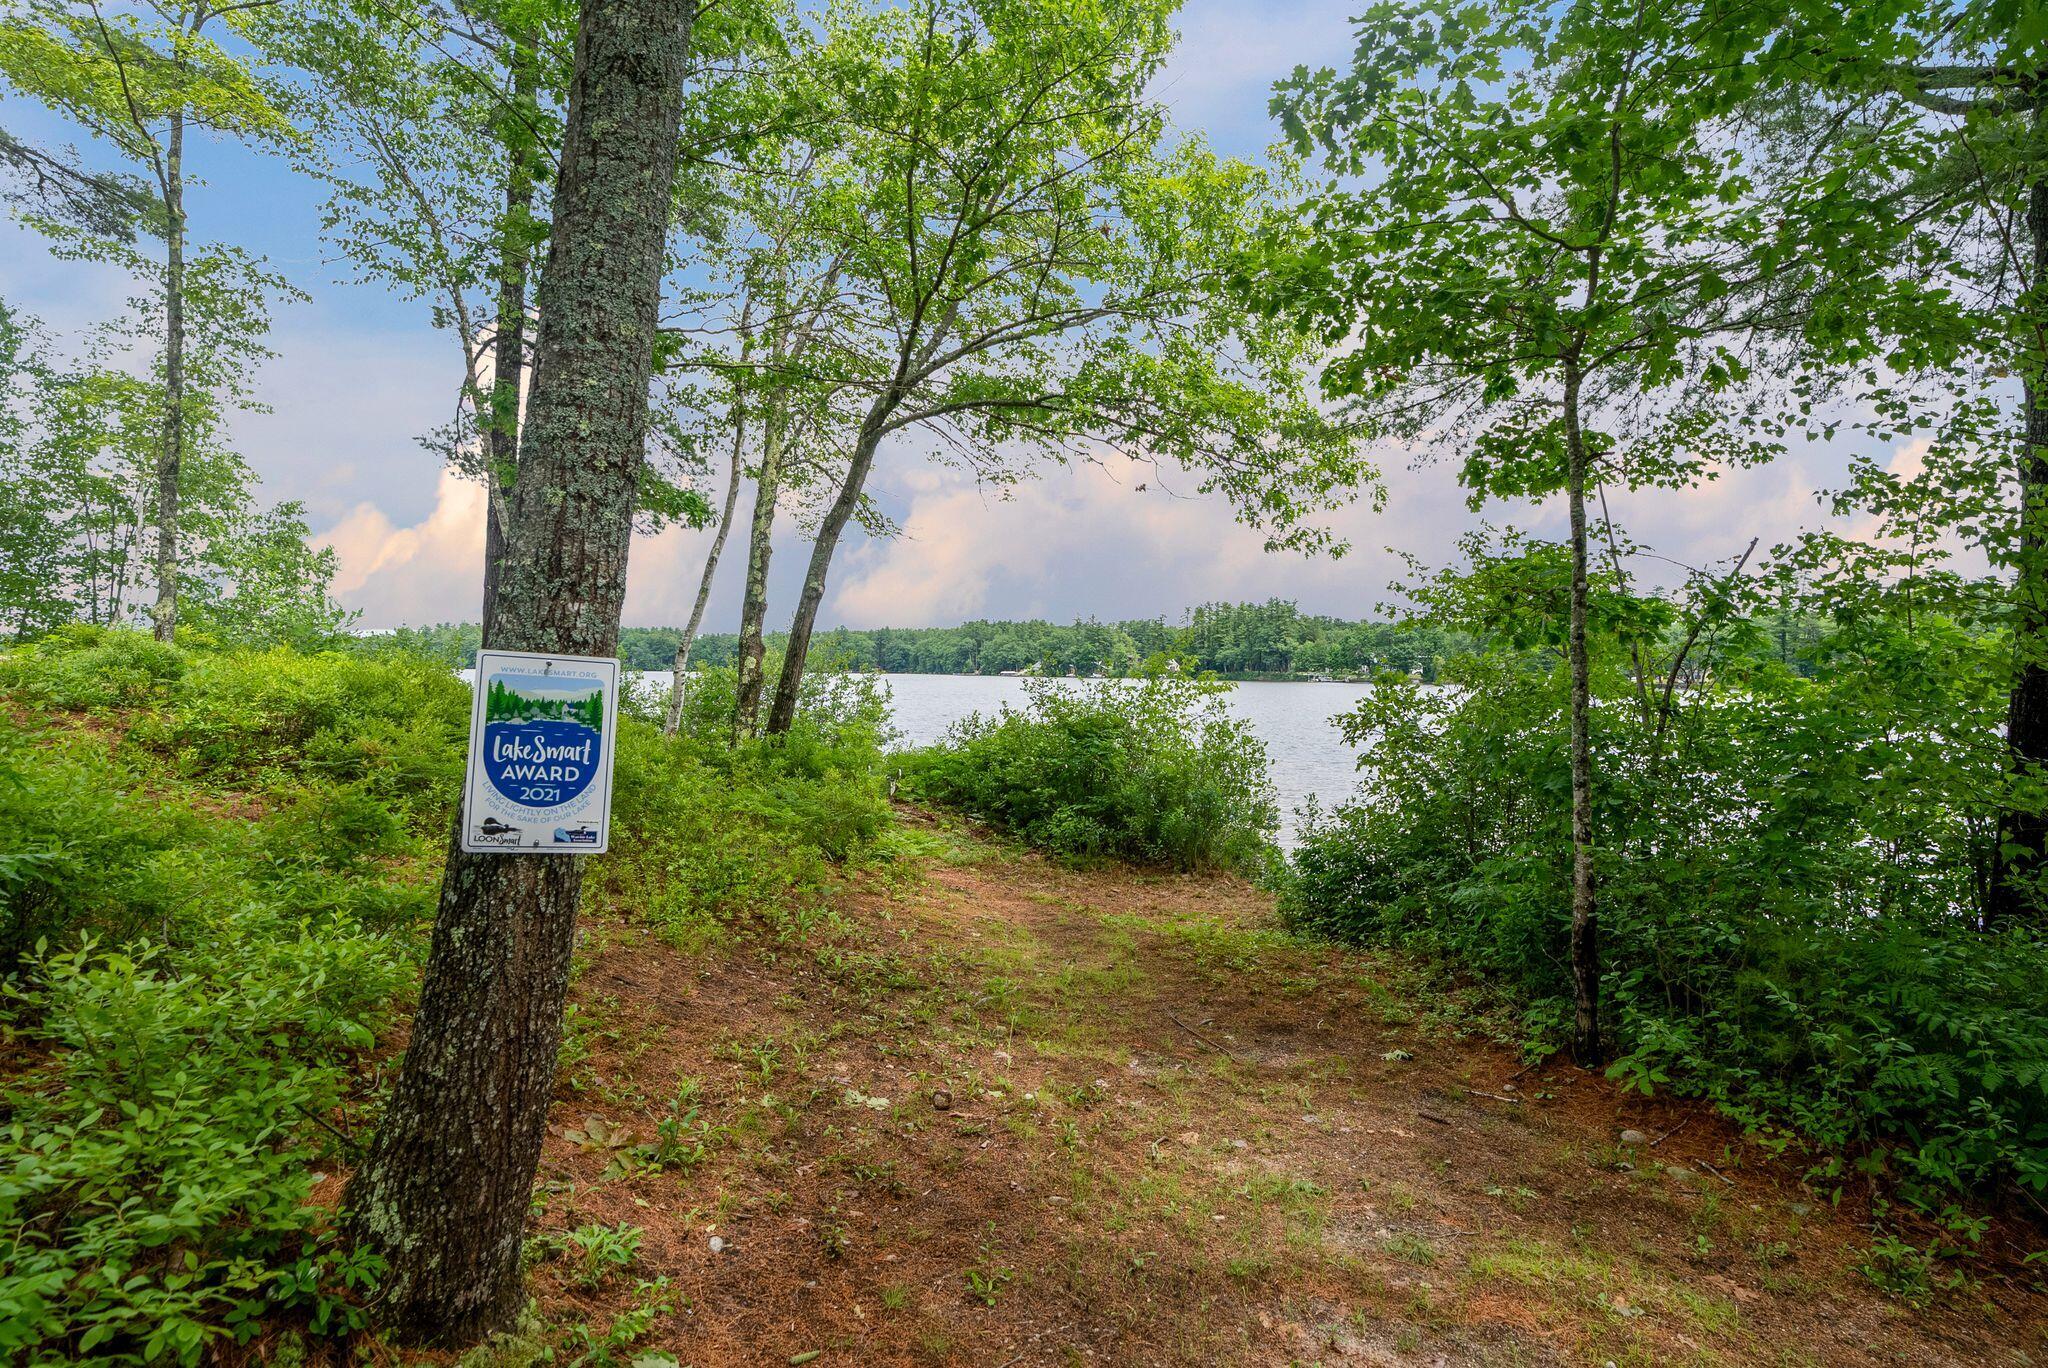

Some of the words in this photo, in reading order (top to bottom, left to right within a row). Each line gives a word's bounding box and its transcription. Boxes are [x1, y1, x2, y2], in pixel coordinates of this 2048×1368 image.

[500, 666, 597, 679] WWW.LAKSMART.ORG
[493, 735, 591, 765] LakeSmart
[501, 765, 579, 781] AWARD
[482, 781, 504, 804] LIVING
[505, 800, 542, 816] LIGHTLY
[543, 808, 558, 816] ON
[560, 802, 577, 814] THE
[578, 784, 596, 804] LAND
[520, 787, 560, 801] 2021
[485, 797, 499, 812] FOR
[500, 809, 517, 820] THE
[517, 814, 539, 824] SAKE
[540, 816, 552, 824] OF
[554, 810, 573, 822] OUR
[572, 799, 592, 816] LAKE
